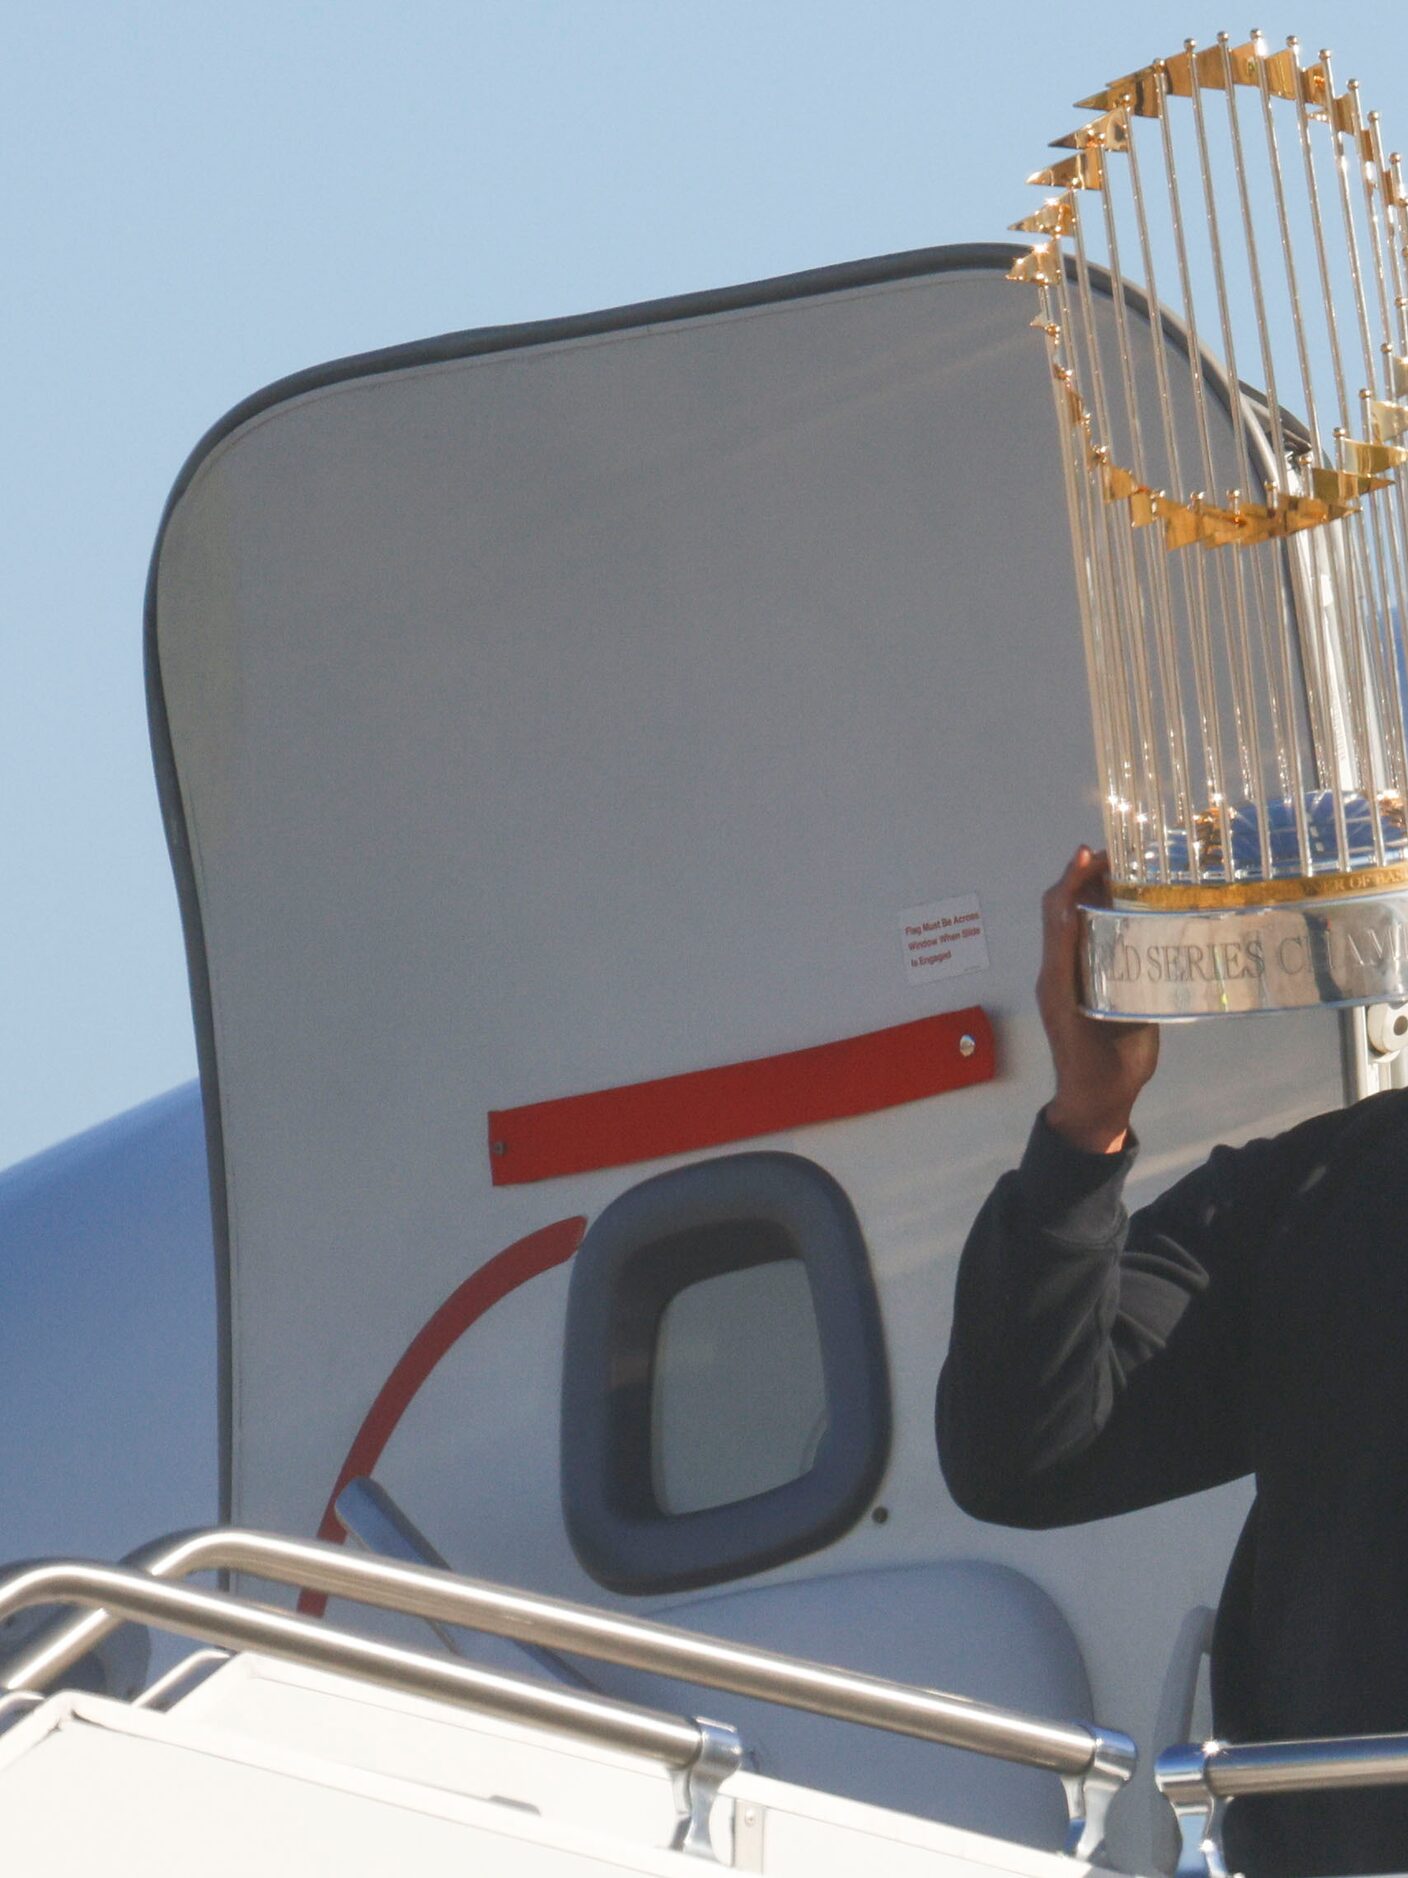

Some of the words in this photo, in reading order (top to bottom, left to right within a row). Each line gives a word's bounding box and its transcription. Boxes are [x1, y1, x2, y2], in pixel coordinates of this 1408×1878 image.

[1350, 876, 1370, 888] OF
[905, 927, 922, 936] Flag
[923, 921, 941, 930] Must
[941, 918, 952, 927] Be
[953, 912, 980, 924] Across
[908, 939, 938, 950] Window
[940, 933, 960, 942] When
[962, 927, 981, 938] Slide
[918, 950, 952, 965] Engaged
[1146, 939, 1265, 983] SERIES
